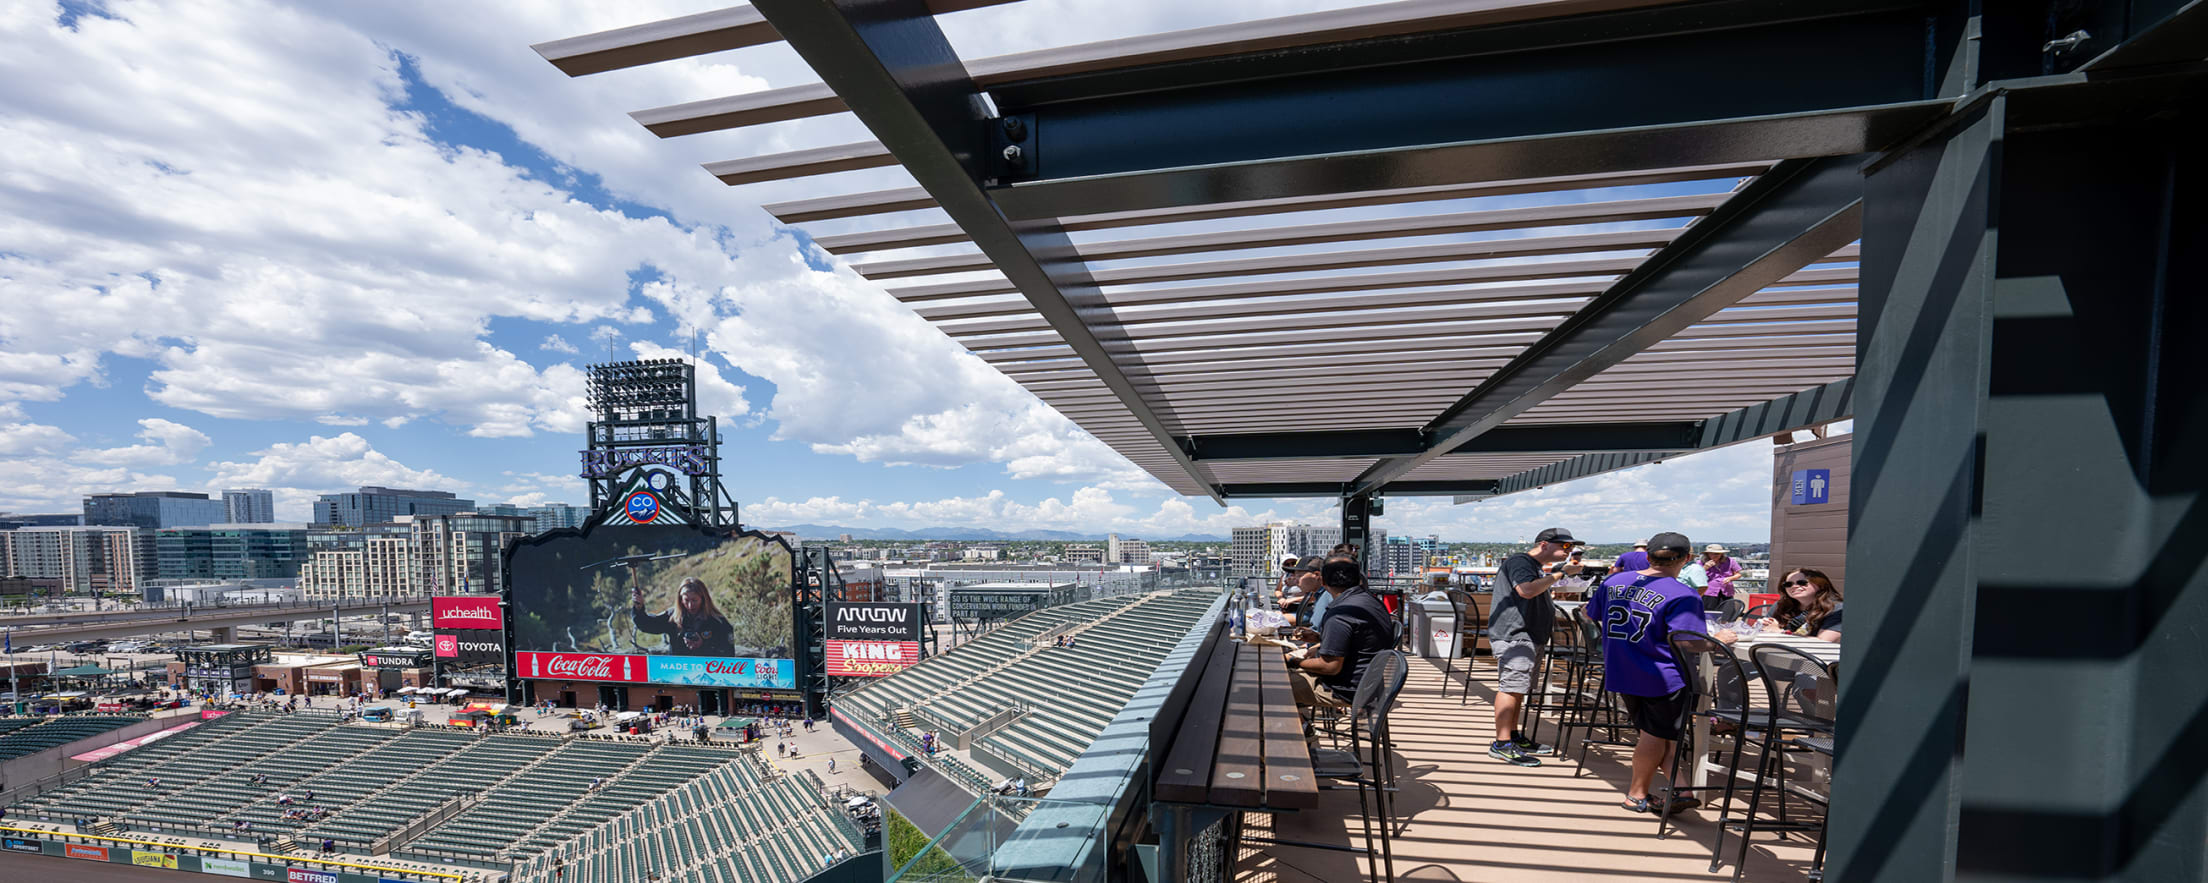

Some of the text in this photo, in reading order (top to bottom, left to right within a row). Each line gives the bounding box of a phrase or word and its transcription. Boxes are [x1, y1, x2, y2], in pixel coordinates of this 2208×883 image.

[579, 446, 707, 478] ROCKIES
[1795, 480, 1803, 496] MEN
[632, 496, 653, 508] CO
[442, 606, 492, 619] uchealth
[836, 607, 907, 622] ARROW
[837, 625, 907, 634] Five Years Out
[1607, 605, 1653, 643] 27
[458, 642, 502, 652] TOYOTA
[842, 643, 902, 659] KING
[377, 656, 414, 666] TUNDRA
[547, 655, 614, 678] Coca-Cola
[691, 663, 704, 671] TO
[705, 660, 748, 675] Chill
[842, 658, 902, 676] Soopers
[289, 871, 337, 883] BETFRED
